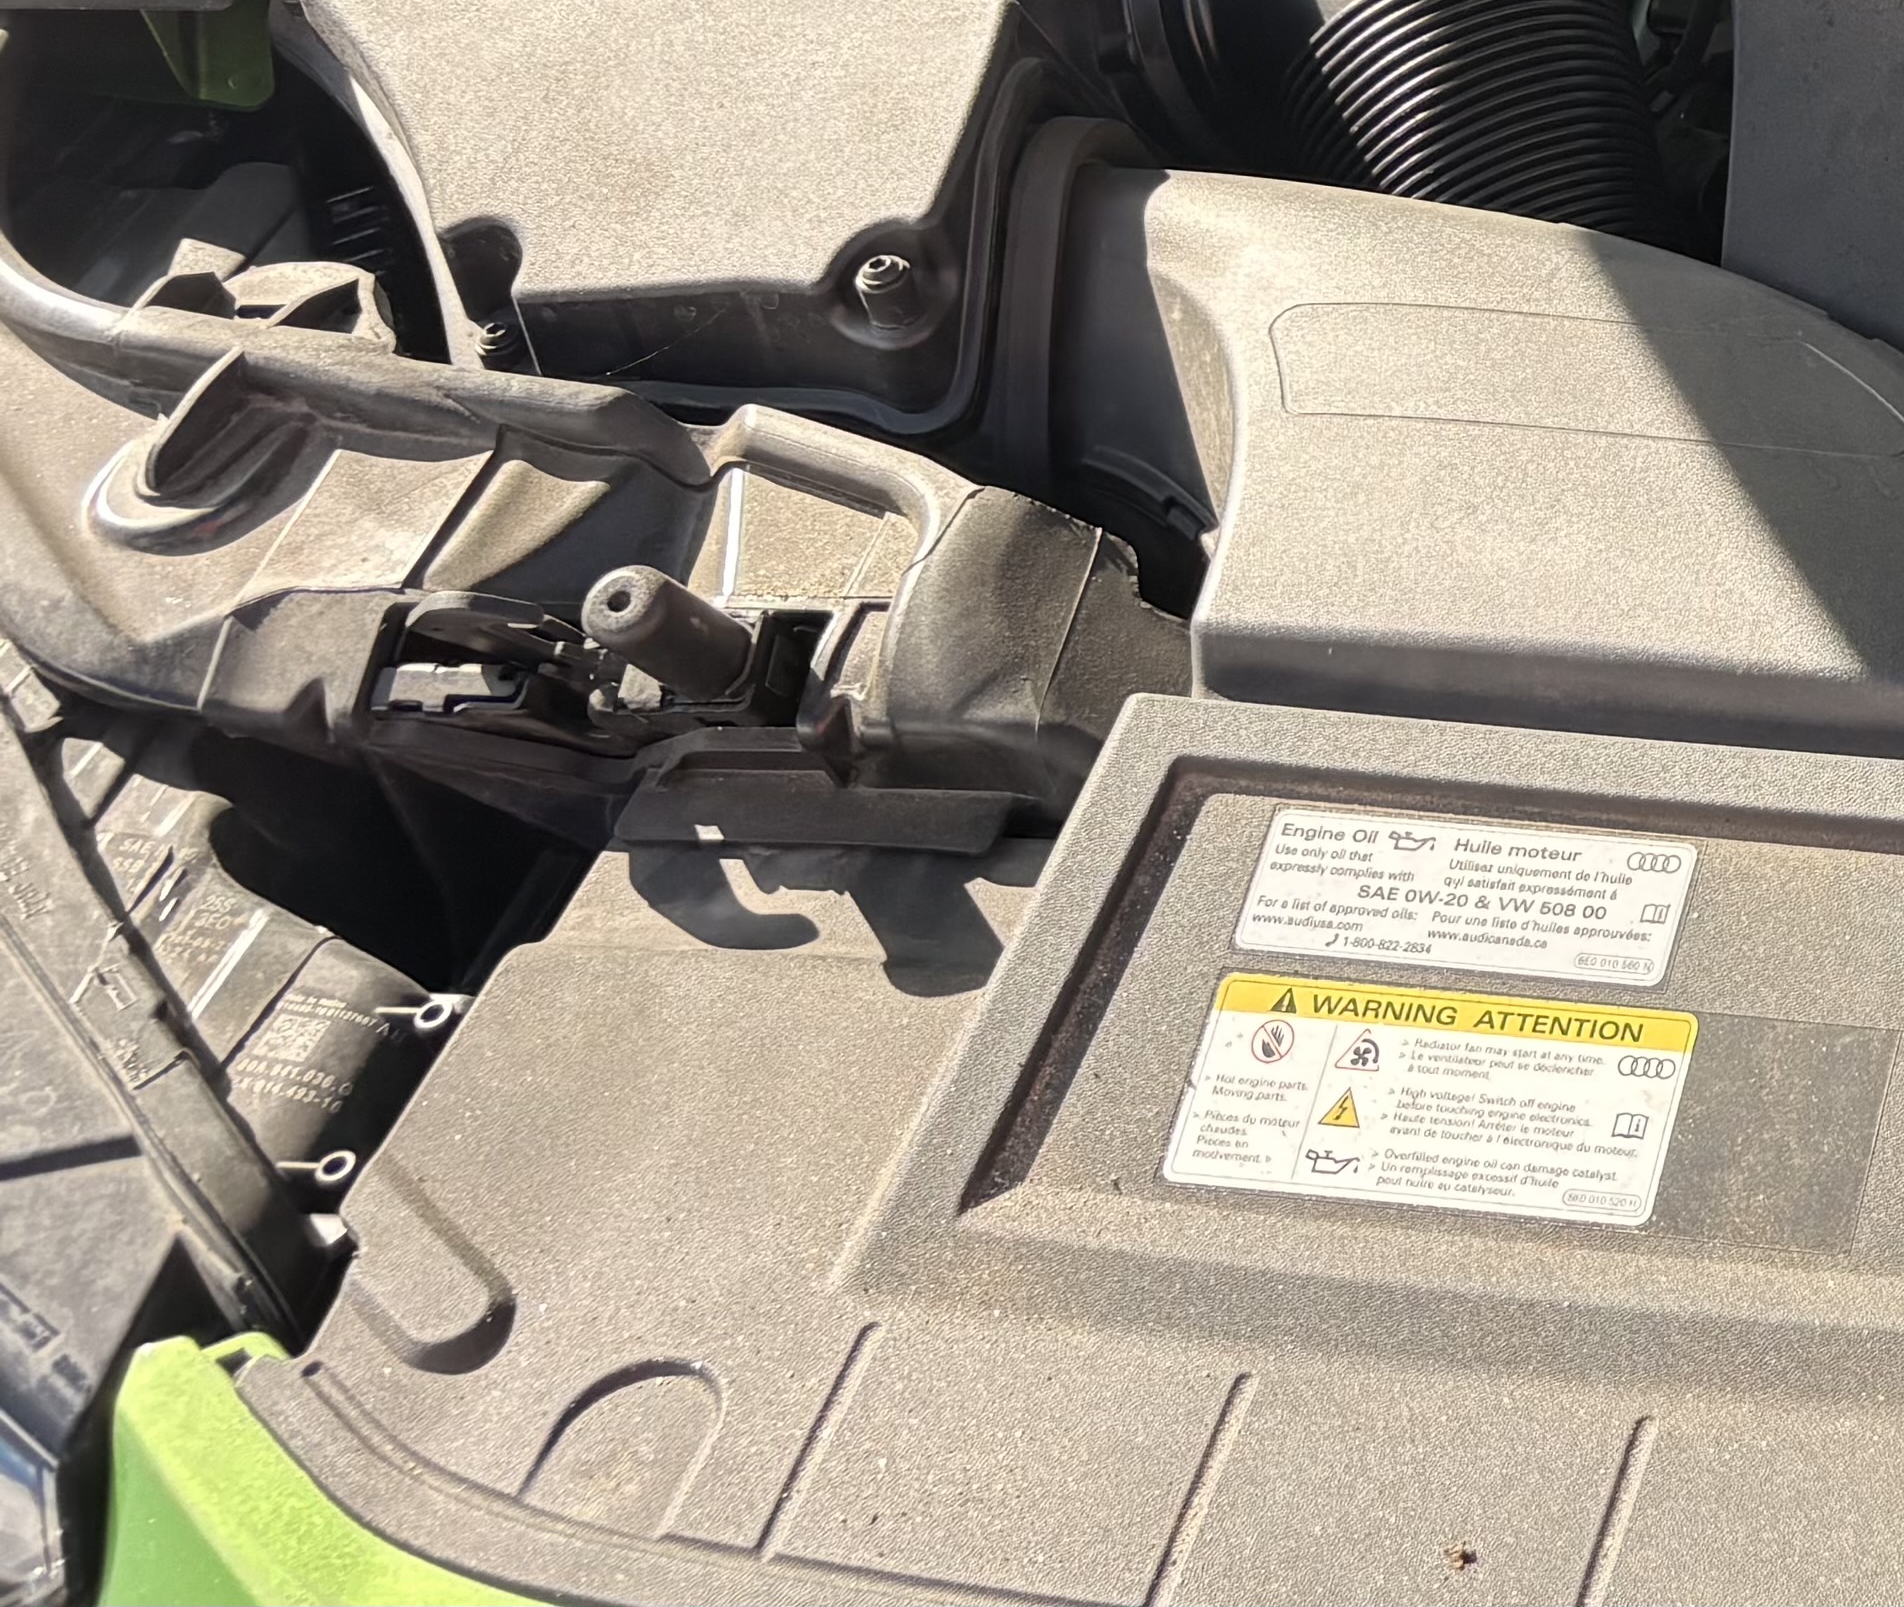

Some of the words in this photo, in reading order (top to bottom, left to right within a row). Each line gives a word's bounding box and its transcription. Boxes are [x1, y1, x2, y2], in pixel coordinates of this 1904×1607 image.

[1281, 823, 1345, 842] Engine
[1352, 829, 1379, 844] Oil
[1275, 844, 1298, 856] Use
[1301, 847, 1328, 861] only
[1330, 849, 1347, 860] oil
[1349, 851, 1373, 862] that
[1454, 838, 1502, 855] Huile
[1508, 847, 1583, 862] moteur
[1270, 861, 1328, 876] expressly
[1330, 865, 1384, 881] complies
[1388, 869, 1415, 883] with
[1497, 864, 1572, 881] uniquement
[1575, 870, 1591, 882] de
[1467, 878, 1516, 892] satisfait
[1518, 883, 1606, 900] expressément
[1257, 895, 1278, 908] For
[1281, 900, 1288, 909] a
[1292, 899, 1310, 911] list
[1313, 900, 1326, 912] of
[1329, 904, 1389, 919] approved
[1391, 909, 1418, 921] oils:
[1357, 885, 1400, 901] SAE
[1405, 890, 1469, 908] 0W-20
[1474, 895, 1490, 909] &
[1499, 897, 1535, 913] VW
[1540, 901, 1576, 917] 508
[1582, 906, 1607, 920] 00
[1252, 913, 1364, 932] www.audiusa.com
[1432, 911, 1462, 925] Pour
[1465, 916, 1488, 927] une
[1492, 917, 1517, 930] liste
[1427, 930, 1548, 949] www.audicanada.ca
[1311, 993, 1459, 1027] WARNING
[1473, 1011, 1644, 1044] ATTENTION
[1401, 1087, 1427, 1101] High
[1534, 1126, 1575, 1138] moteur
[1384, 1148, 1440, 1165] Overfilled
[1442, 1156, 1481, 1169] engine
[1523, 1163, 1570, 1178] damage
